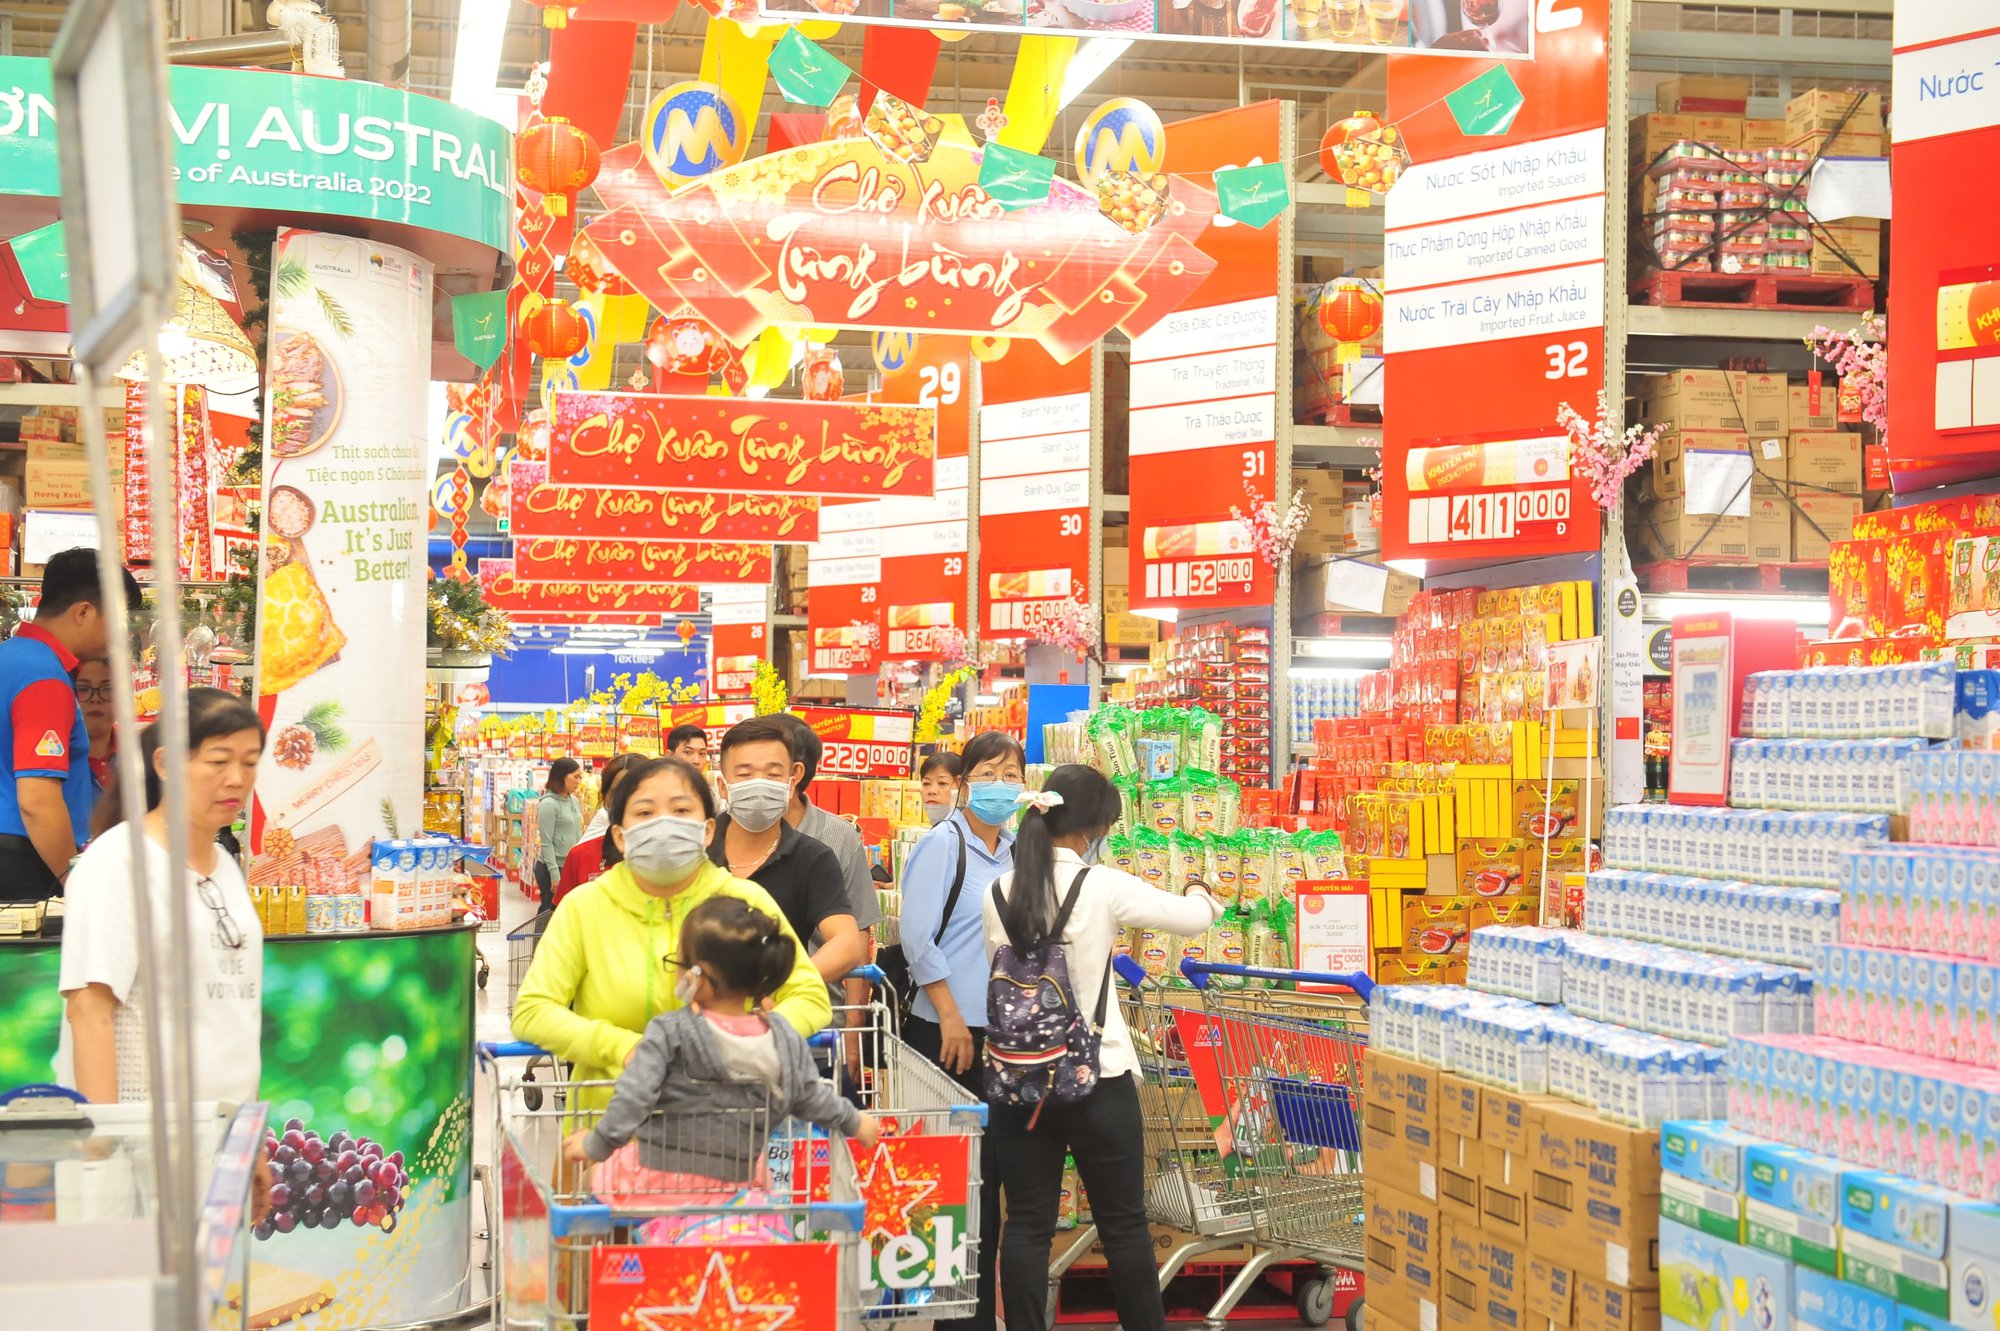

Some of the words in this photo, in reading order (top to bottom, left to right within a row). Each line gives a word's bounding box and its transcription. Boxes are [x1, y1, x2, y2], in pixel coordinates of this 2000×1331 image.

[787, 67, 815, 90] AUSTRALIA
[1920, 69, 1984, 101] Nước
[1477, 100, 1504, 120] AUSTRALIA
[188, 163, 223, 183] of
[228, 165, 364, 195] Australia
[369, 177, 432, 205] 2022
[811, 162, 904, 226] Chợ
[1499, 180, 1544, 198] Imported
[1547, 173, 1587, 189] Sauces
[1468, 249, 1513, 268] Imported
[1516, 241, 1556, 258] Canned
[1559, 237, 1588, 252] Good
[314, 263, 352, 274] AUSTRALIA
[1480, 315, 1526, 333] Imported
[1528, 309, 1554, 325] Fruit
[1558, 308, 1586, 323] Juice
[1545, 341, 1588, 380] 32
[919, 362, 961, 405] 29
[569, 414, 646, 465] Chợ
[647, 410, 729, 463] Xuân
[331, 444, 361, 462] Thịt
[363, 444, 394, 462] sạch
[1242, 450, 1265, 477] 31
[306, 467, 336, 486] Tiệc
[341, 469, 375, 486] ngon
[377, 467, 384, 481] 5
[1437, 461, 1478, 487] PROMOTION
[320, 496, 420, 525] Australian,
[526, 484, 586, 519] Chợ
[1060, 514, 1082, 536] 30
[345, 527, 383, 553] It's
[387, 527, 413, 552] Just
[354, 556, 410, 582] Better!
[943, 557, 962, 576] 29
[861, 587, 876, 603] 28
[751, 626, 763, 639] 26
[613, 653, 655, 664] Textiles
[292, 788, 321, 809] MERRY
[324, 752, 372, 789] CHRISTMAS
[1407, 1074, 1427, 1095] PURE
[1406, 1093, 1427, 1114] MILK
[1589, 1139, 1616, 1165] PURE
[1589, 1161, 1617, 1187] MILK
[1408, 1212, 1428, 1234] PURE
[1407, 1230, 1428, 1254] MILK
[1491, 1245, 1514, 1271] PURE
[1489, 1265, 1513, 1292] MILK
